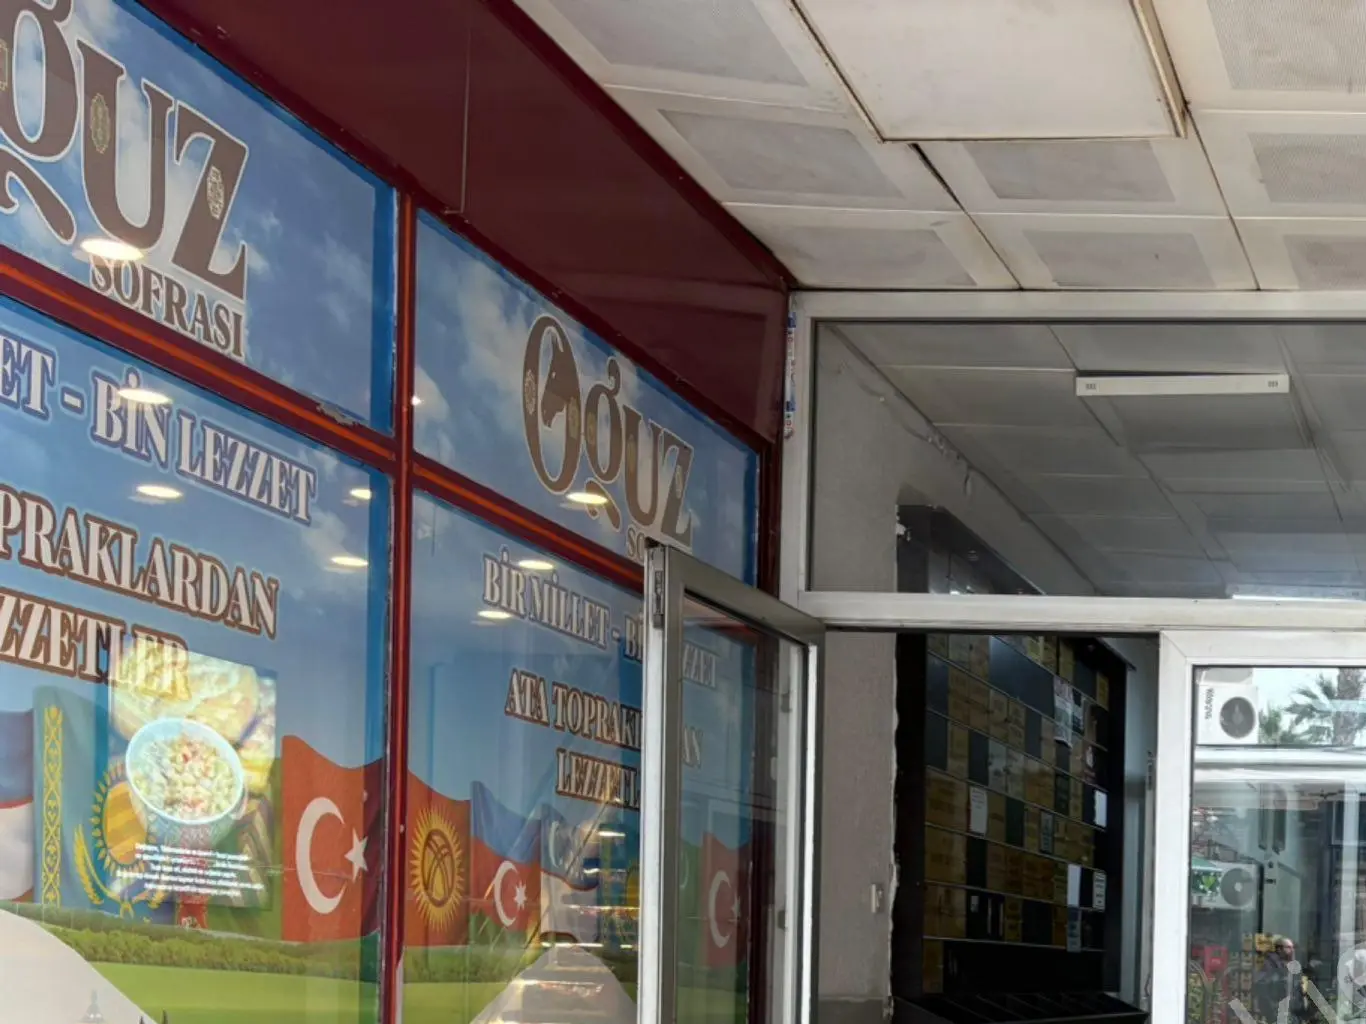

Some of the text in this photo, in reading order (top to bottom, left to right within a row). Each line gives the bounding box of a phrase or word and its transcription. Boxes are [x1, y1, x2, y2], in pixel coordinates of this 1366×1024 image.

[90, 257, 245, 359] SOFRASI
[92, 368, 171, 469] BİN
[177, 412, 316, 525] LEZZET
[483, 546, 527, 620] BİR
[528, 570, 610, 650] MİLLET
[505, 669, 549, 726] ATA
